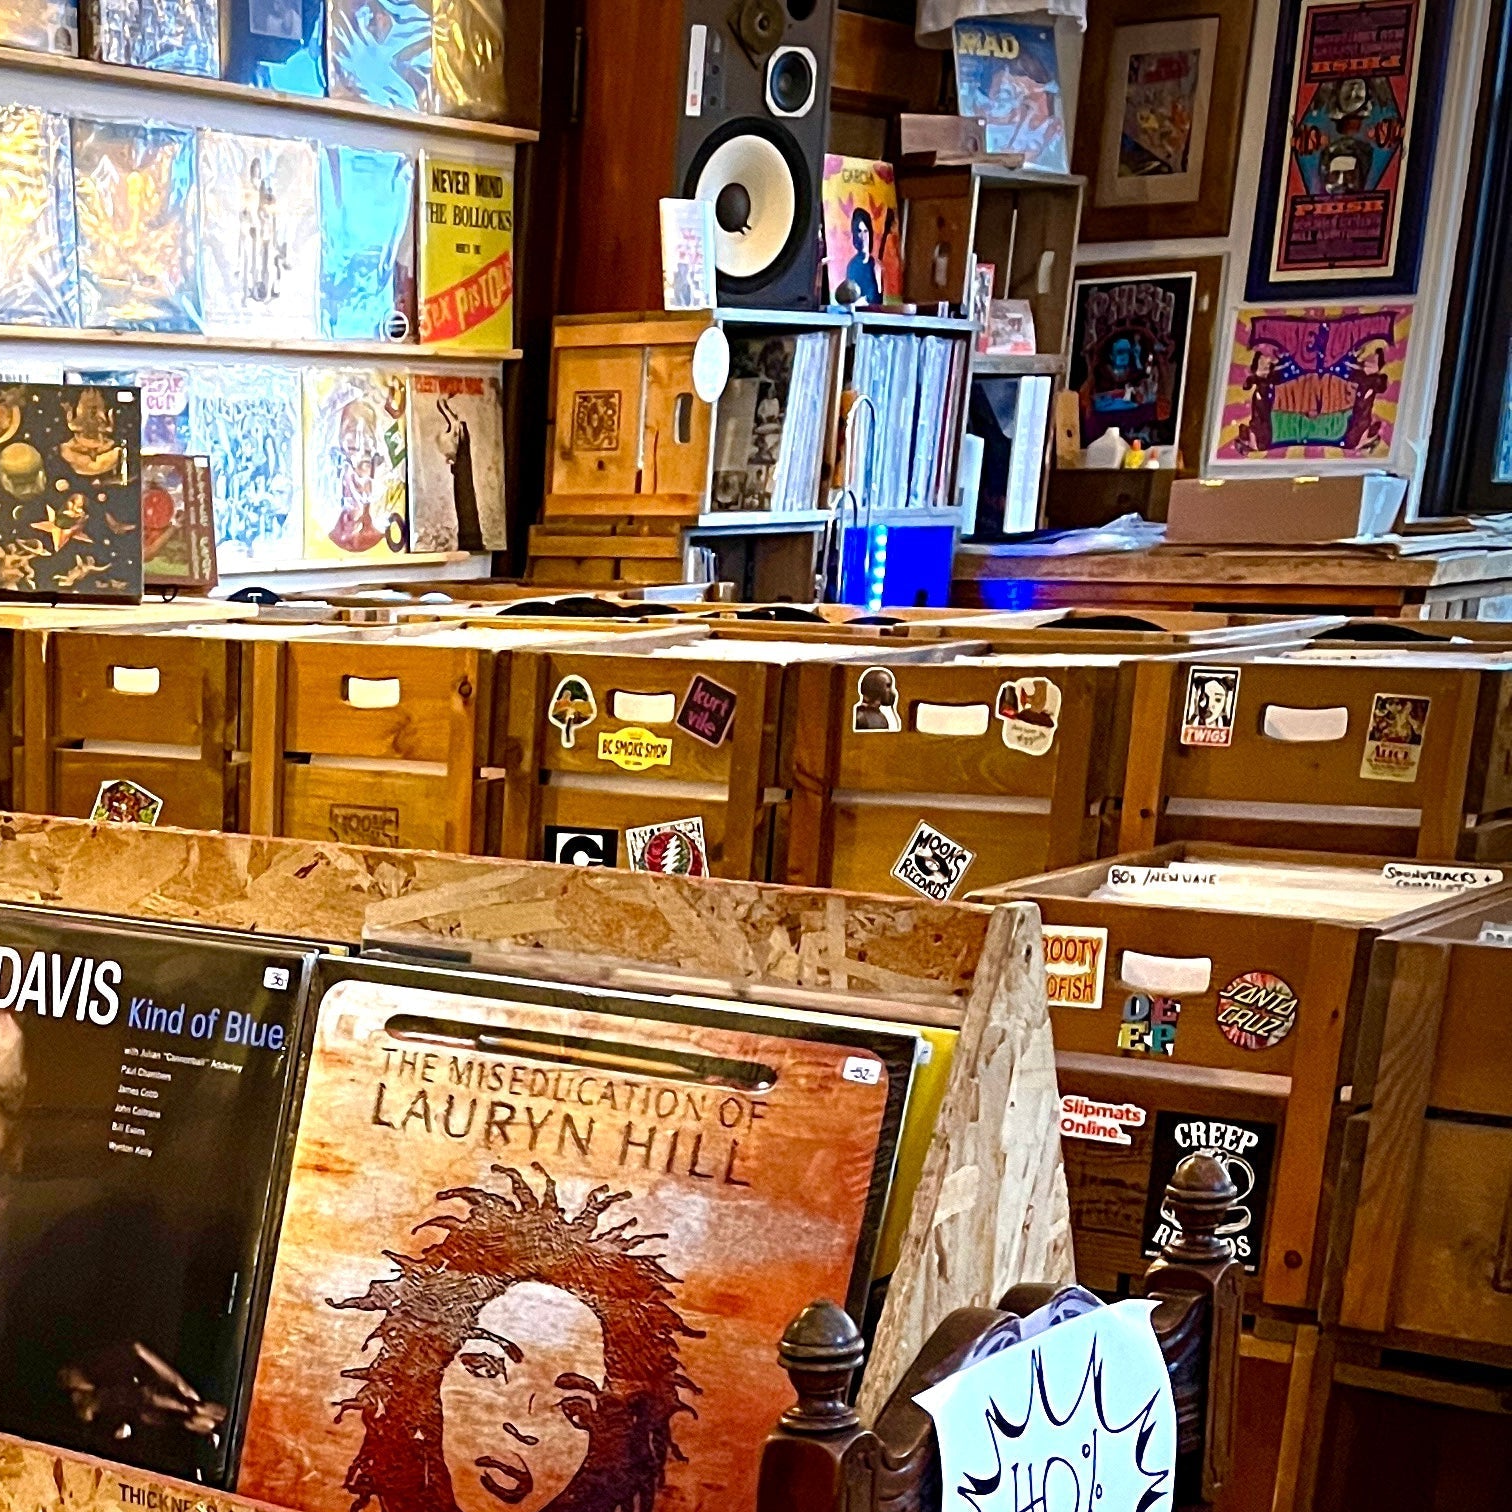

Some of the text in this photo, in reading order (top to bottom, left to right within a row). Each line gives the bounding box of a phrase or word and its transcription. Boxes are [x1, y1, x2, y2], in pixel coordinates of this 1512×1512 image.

[959, 32, 1020, 60] MAD
[432, 167, 504, 200] NEVER MIND
[842, 168, 875, 185] GARCIA
[425, 201, 512, 232] THE BOLLOCKS
[693, 681, 730, 718] kurt
[687, 709, 717, 738] vile
[1186, 726, 1228, 744] TWIGS
[602, 738, 613, 755] BC
[615, 740, 643, 757] SMOKE
[644, 743, 668, 760] SHOP
[898, 857, 950, 900] RECORDS
[1047, 972, 1096, 1003] OFISH
[1219, 982, 1298, 1016] SANTA
[128, 996, 285, 1051] Kind of Blue
[1216, 1005, 1285, 1036] CRUZ
[382, 1047, 770, 1134] THE MISEDUCATION OF
[1062, 1097, 1142, 1123] Slipmats
[371, 1082, 752, 1189] LAURYN HILL
[1060, 1117, 1119, 1140] Online
[1173, 1121, 1259, 1154] CREEP
[1151, 1223, 1252, 1258] REDS
